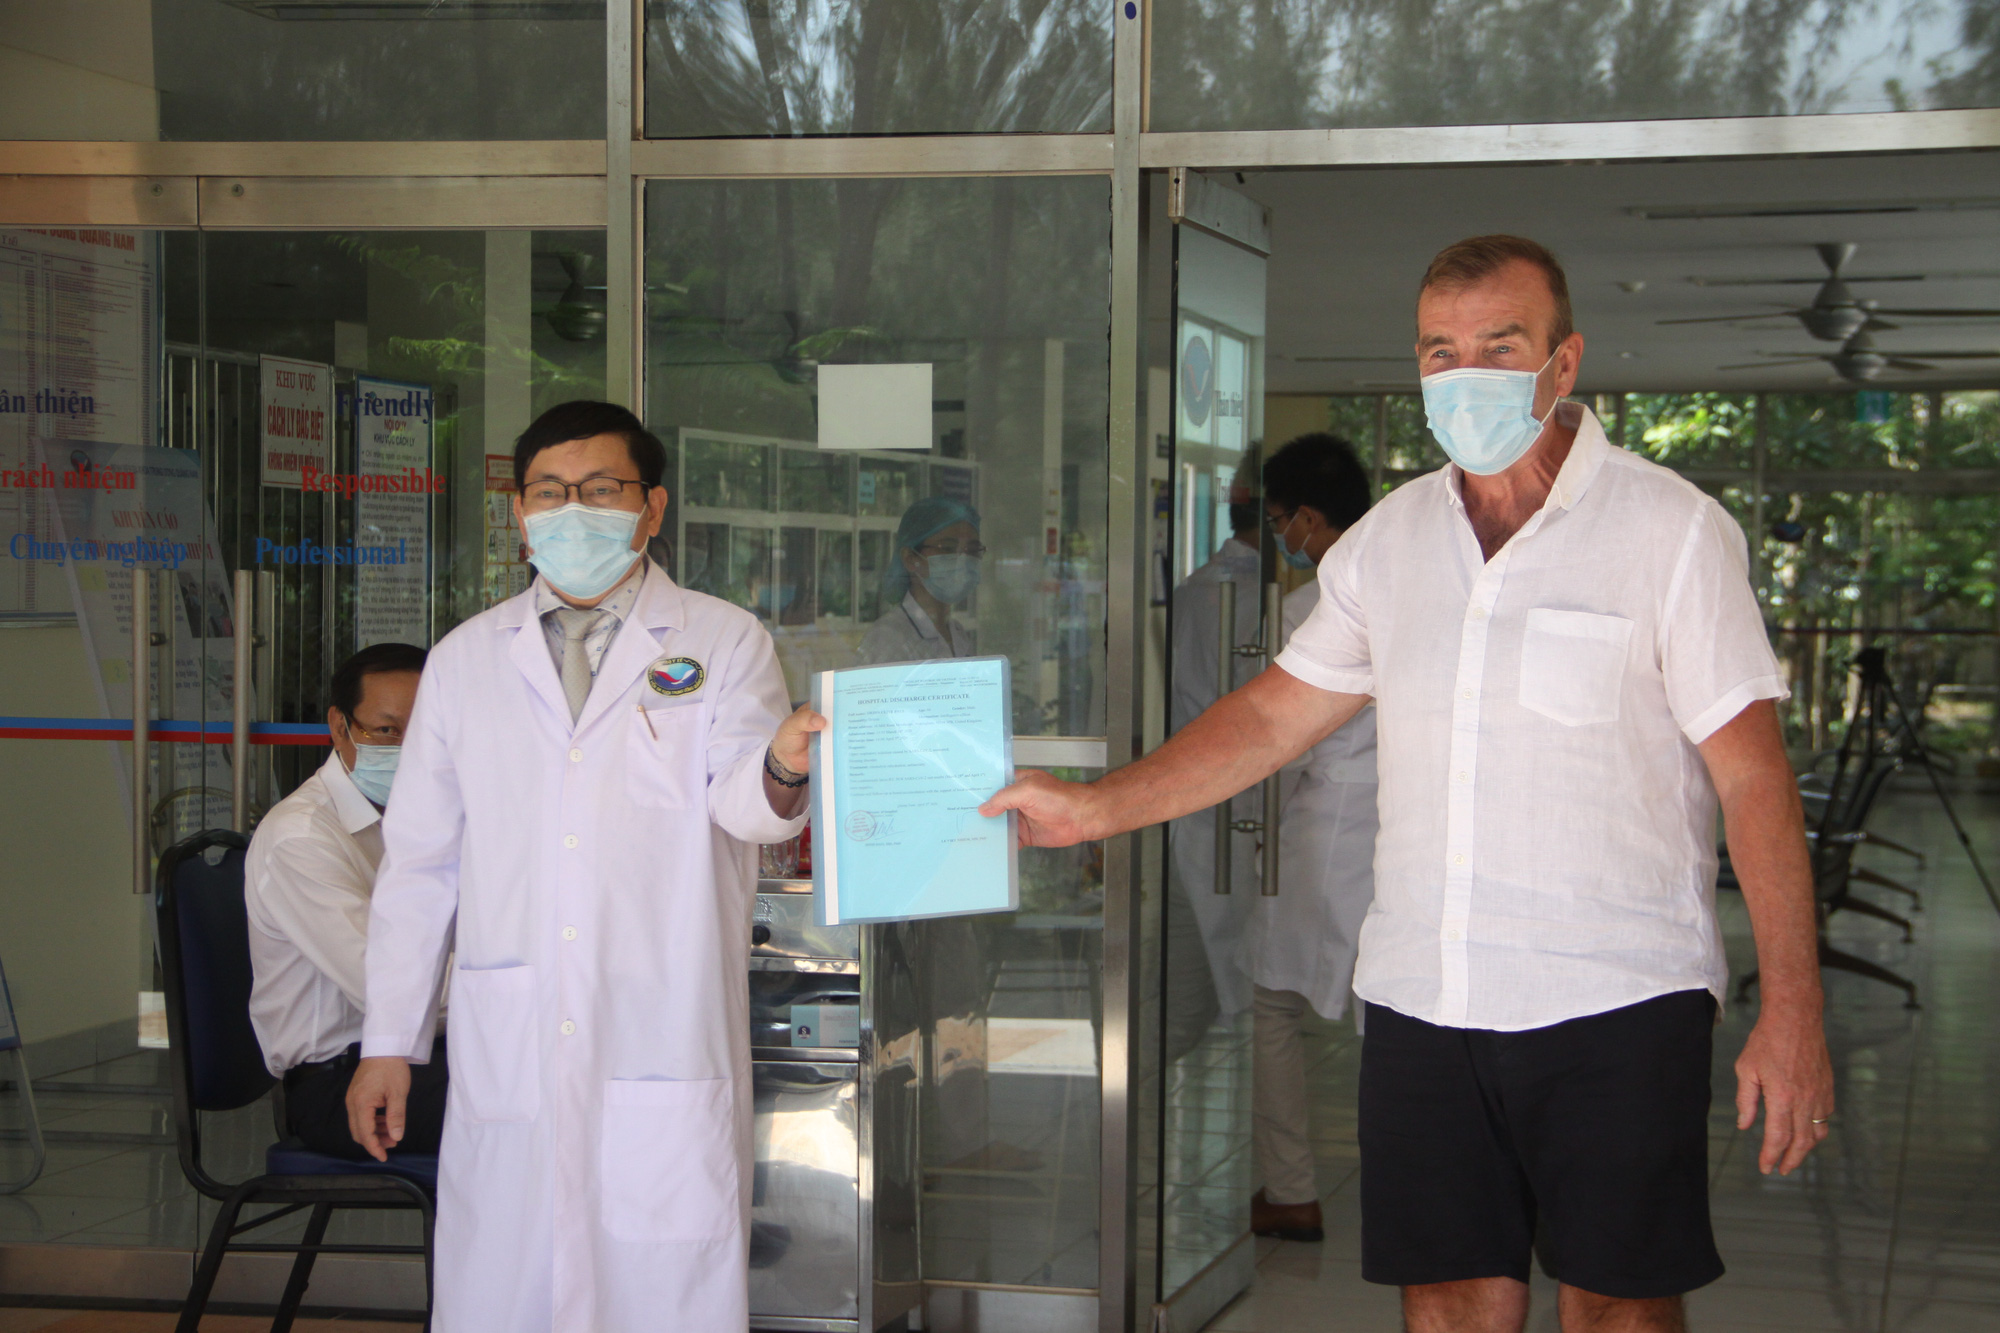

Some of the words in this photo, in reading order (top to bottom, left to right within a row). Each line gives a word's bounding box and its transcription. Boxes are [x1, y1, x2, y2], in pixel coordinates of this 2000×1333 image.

[113, 234, 135, 251] NAM
[276, 370, 296, 389] KHU
[298, 372, 316, 396] VỰC
[35, 387, 96, 420] thiện
[336, 391, 435, 424] Friendly
[267, 398, 286, 437] CÁCH
[287, 407, 296, 438] LY
[296, 403, 310, 445] ĐẶC
[311, 405, 325, 447] BIỆT
[0, 462, 55, 489] rách
[64, 463, 136, 494] nhiệm
[301, 466, 446, 500] Responsible
[10, 533, 98, 567] Chuyên
[106, 535, 188, 569] nghiệp
[255, 537, 407, 565] Professional
[928, 693, 970, 701] CERTIFICATE
